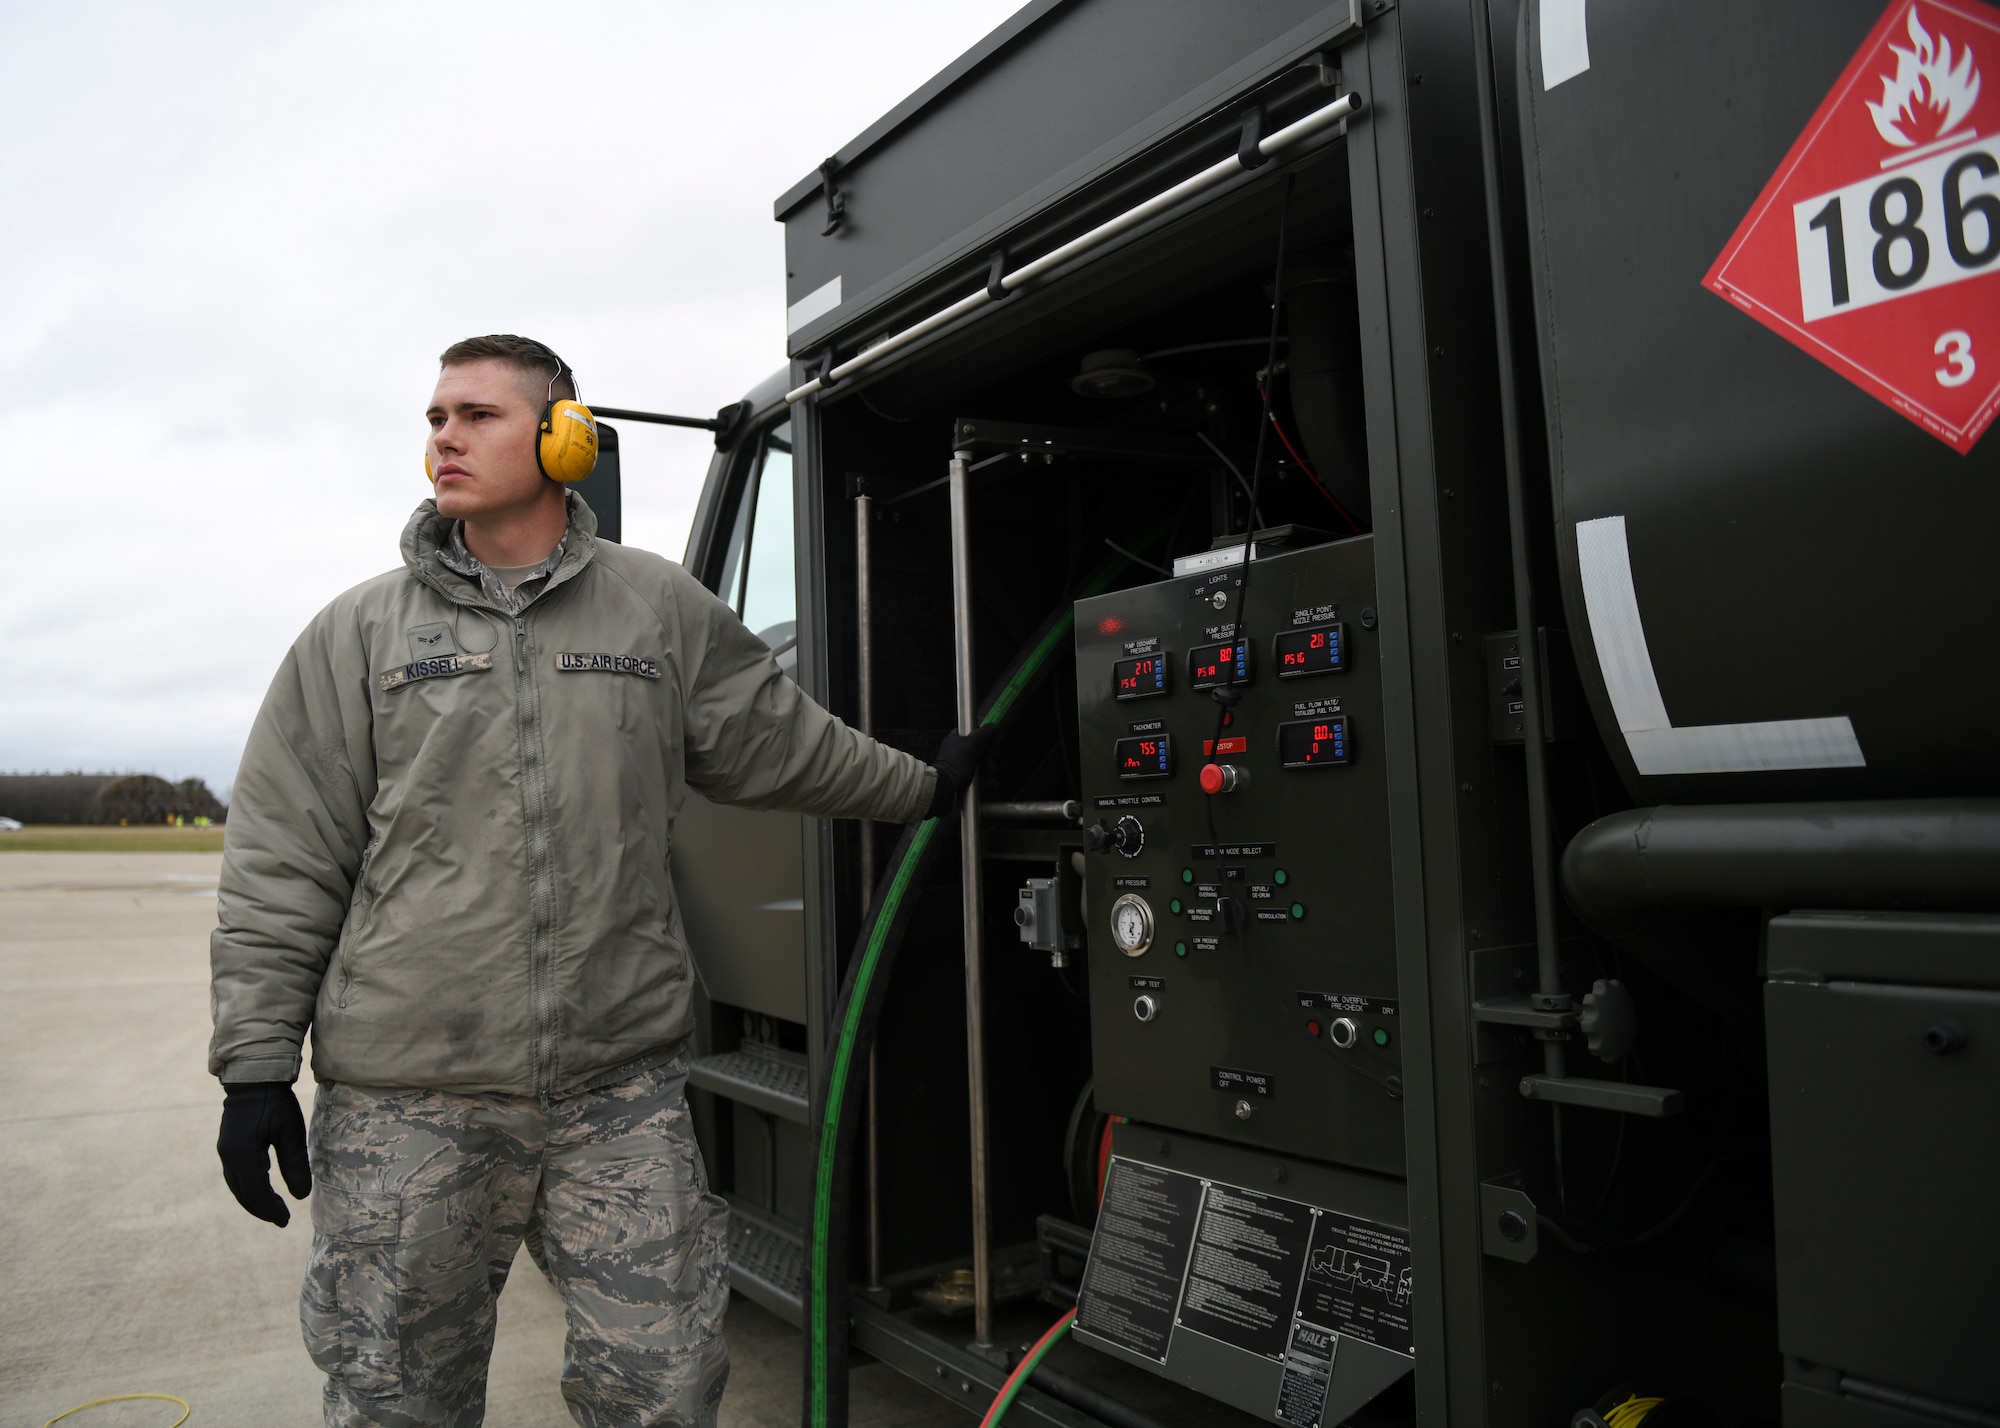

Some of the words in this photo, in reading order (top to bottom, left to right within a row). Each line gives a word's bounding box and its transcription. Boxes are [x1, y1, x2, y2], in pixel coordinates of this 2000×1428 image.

[1934, 330, 1976, 387] 3
[1209, 574, 1227, 584] LIGHTS
[1195, 587, 1205, 595] OFF
[1295, 609, 1313, 617] SINGLE
[1316, 605, 1332, 614] POINT
[1293, 616, 1310, 625] NOZZLE
[1312, 612, 1335, 622] PRESSURE
[1206, 627, 1218, 635] PUMP
[1137, 639, 1157, 647] DISCHARGE
[1130, 646, 1152, 654] PRESSURE
[406, 659, 463, 679] KISSELL
[562, 655, 587, 668] U.S.
[592, 656, 612, 668] AIR
[615, 658, 655, 675] FORCE
[1133, 722, 1162, 731] TACHOMETER
[1139, 741, 1156, 755] 755
[1242, 847, 1261, 855] SELECT
[1324, 994, 1339, 1002] TANK
[1341, 996, 1369, 1006] OVERFILL
[1331, 1002, 1363, 1012] PRE-CHECK
[1382, 1007, 1394, 1015] DRY
[1219, 1071, 1243, 1082] CONTROL
[1246, 1075, 1266, 1085] POWER
[1258, 1086, 1266, 1094] ON
[1391, 1235, 1404, 1244] DATA
[1297, 1329, 1329, 1349] HALE
